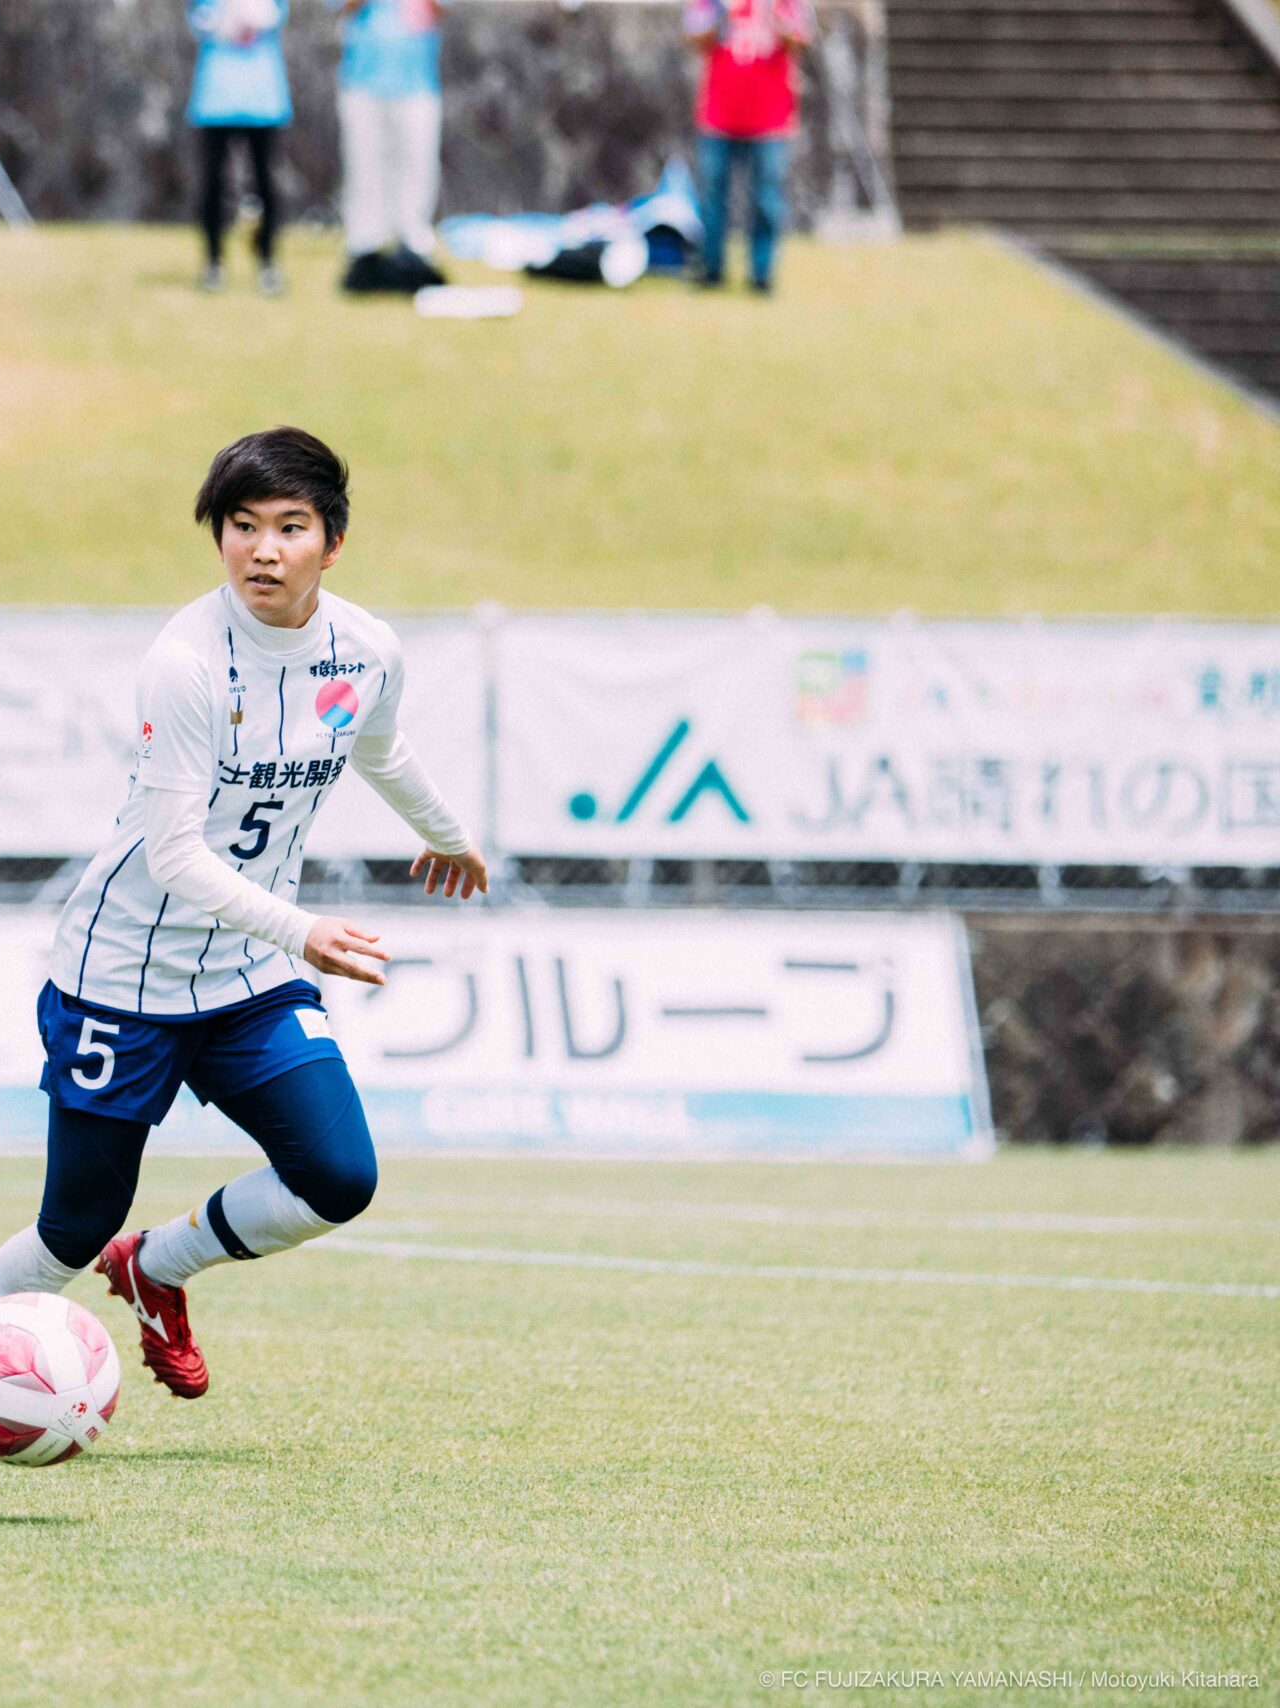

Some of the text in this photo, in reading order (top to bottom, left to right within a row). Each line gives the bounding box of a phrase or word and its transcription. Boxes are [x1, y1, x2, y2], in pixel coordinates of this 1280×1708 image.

[218, 754, 347, 789] 士観光開発
[229, 801, 284, 860] 5
[71, 1016, 120, 1090] 5
